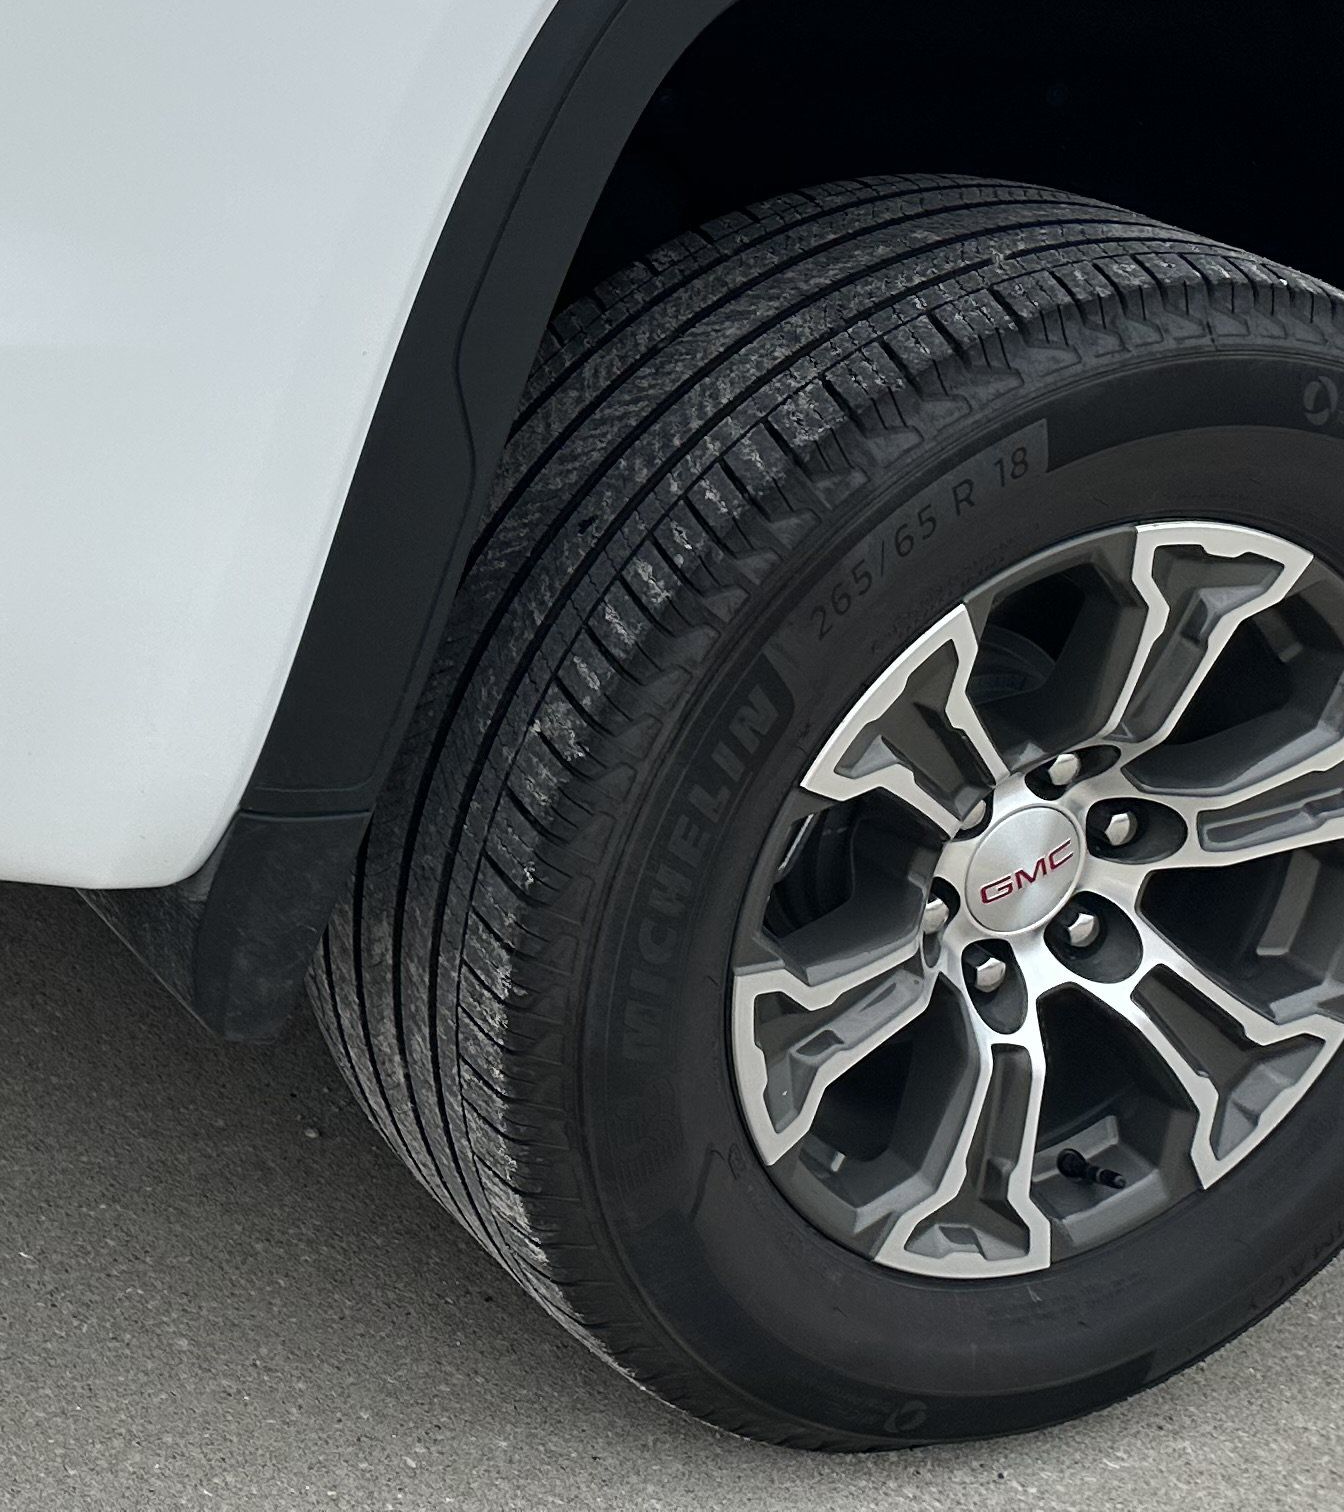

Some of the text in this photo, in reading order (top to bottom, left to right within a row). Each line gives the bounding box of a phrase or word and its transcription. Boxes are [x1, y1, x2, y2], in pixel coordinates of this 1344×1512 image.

[810, 503, 938, 641] 265/65
[951, 478, 976, 517] R
[994, 446, 1030, 488] 18
[621, 688, 781, 1064] MICHELIN
[980, 837, 1074, 904] GMC
